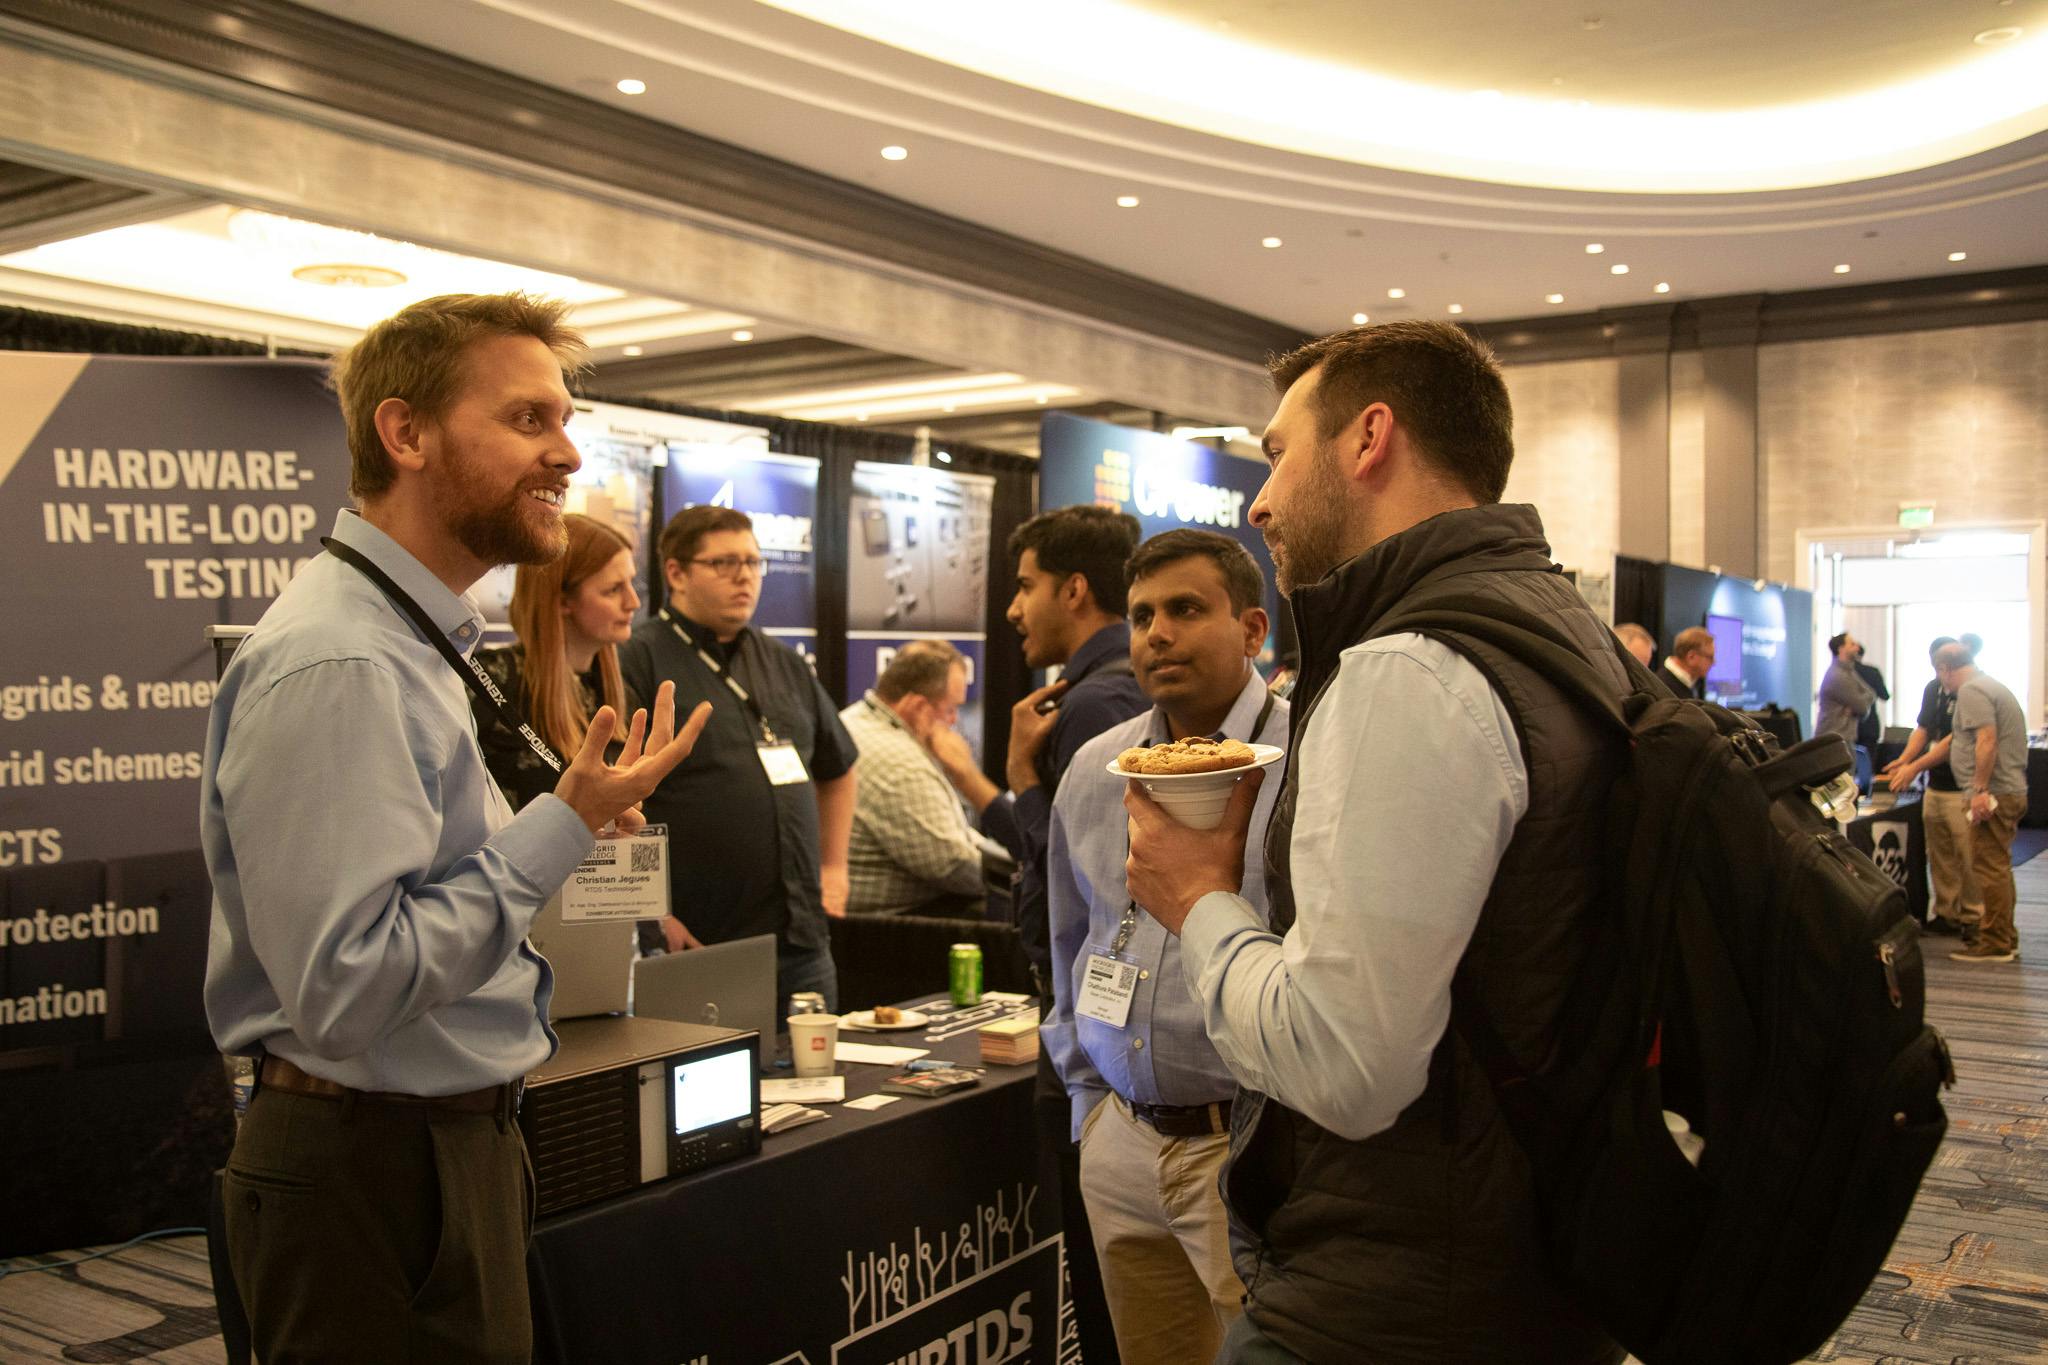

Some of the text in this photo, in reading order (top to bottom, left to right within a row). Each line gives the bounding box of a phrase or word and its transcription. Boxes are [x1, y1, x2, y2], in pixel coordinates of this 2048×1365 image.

[54, 448, 314, 490] HARDWARE-
[42, 502, 317, 544] IN-THE-LOOP
[146, 557, 312, 599] TESTIN
[0, 675, 93, 721] grids
[100, 674, 128, 711] &
[469, 656, 507, 707] XENDEE
[54, 746, 202, 784] schemes
[576, 876, 616, 884] Christian
